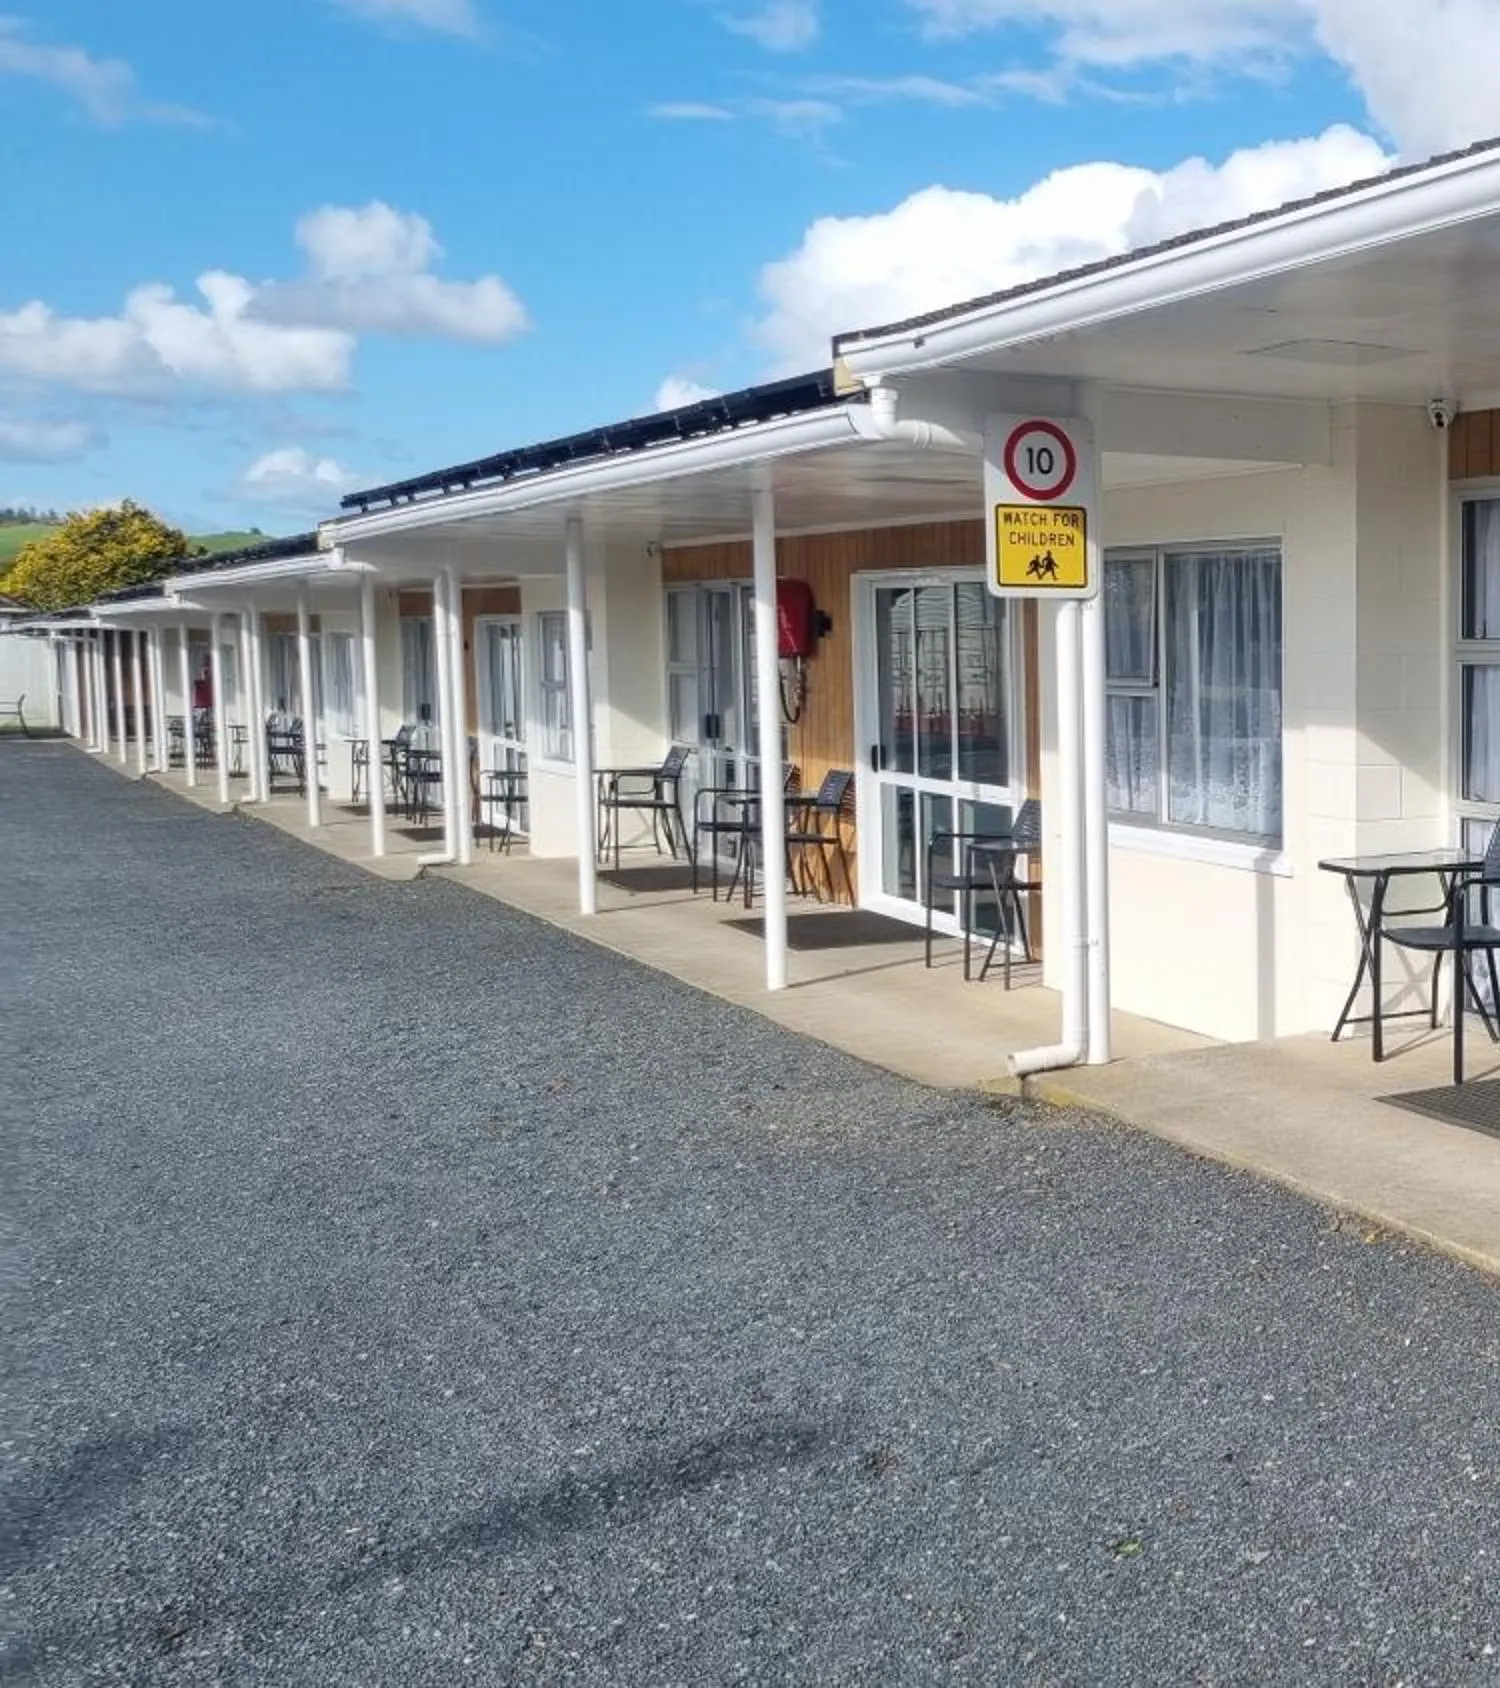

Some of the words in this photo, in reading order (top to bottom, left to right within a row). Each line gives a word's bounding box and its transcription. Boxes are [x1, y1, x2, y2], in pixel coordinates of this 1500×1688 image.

[1026, 447, 1054, 475] 10
[1003, 512, 1047, 526] WATCH
[1053, 513, 1079, 527] FOR
[1009, 531, 1075, 546] CHILDREN
